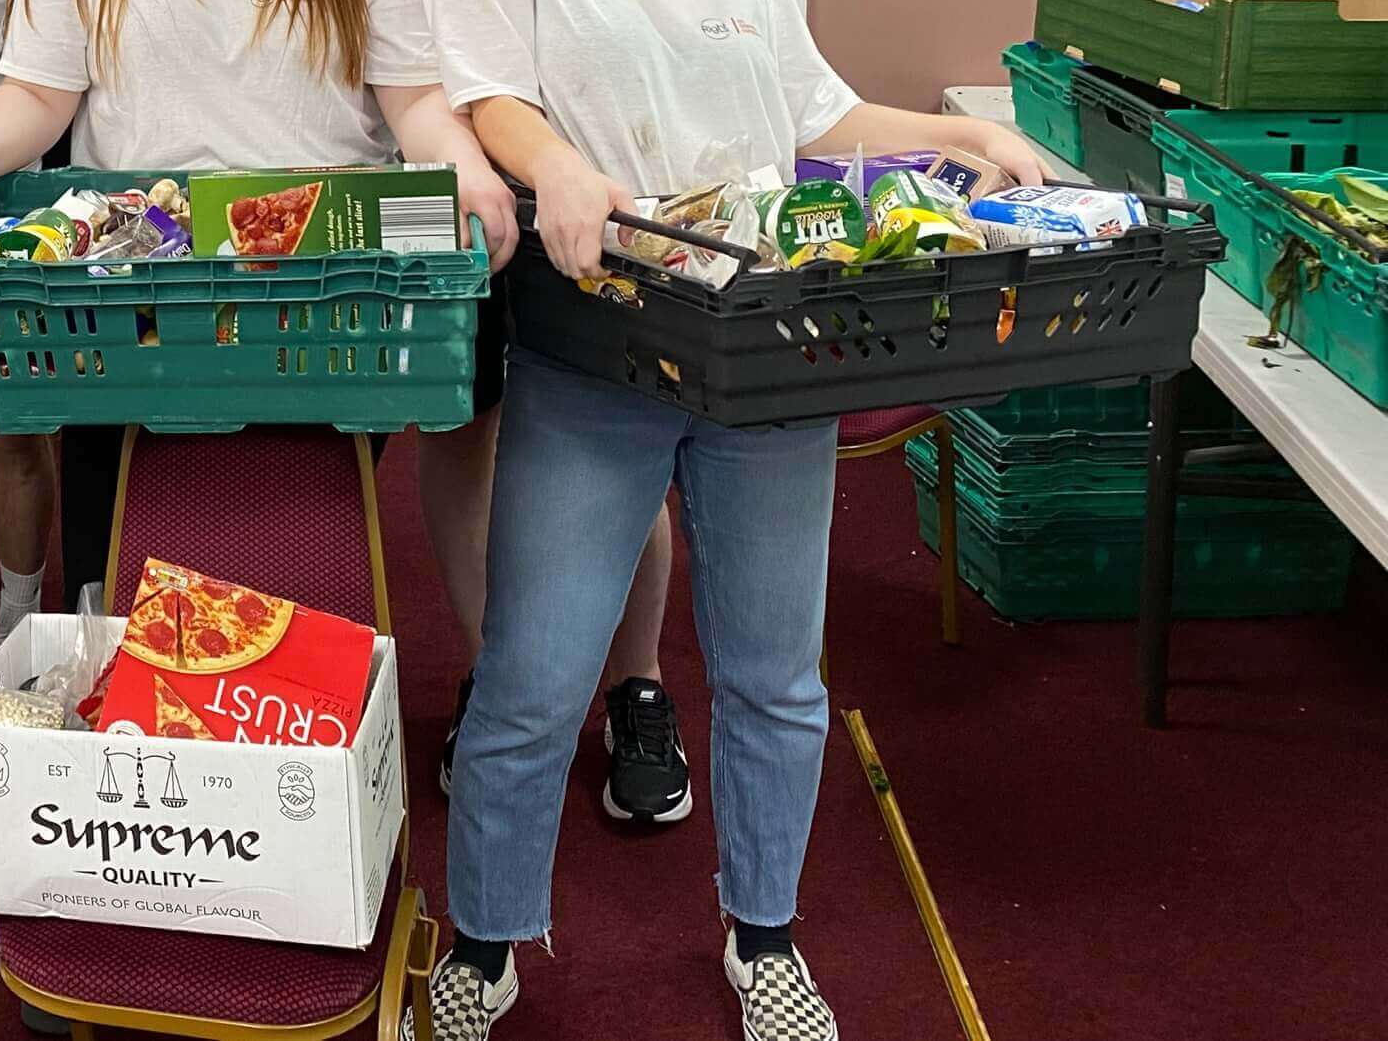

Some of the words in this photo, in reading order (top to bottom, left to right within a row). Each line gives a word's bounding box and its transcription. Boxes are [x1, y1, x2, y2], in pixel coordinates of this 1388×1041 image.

[355, 222, 364, 237] last
[794, 216, 848, 245] POT
[203, 678, 348, 748] CRUST
[312, 694, 353, 718] PIZZA
[48, 764, 71, 778] EST
[203, 775, 233, 789] 1970
[30, 804, 261, 862] Supreme
[102, 867, 196, 888] QUALITY
[42, 892, 106, 908] PIONEERS
[111, 898, 130, 910] OF
[135, 900, 192, 915] GLOBAL
[196, 904, 262, 921] FLAVOUR
